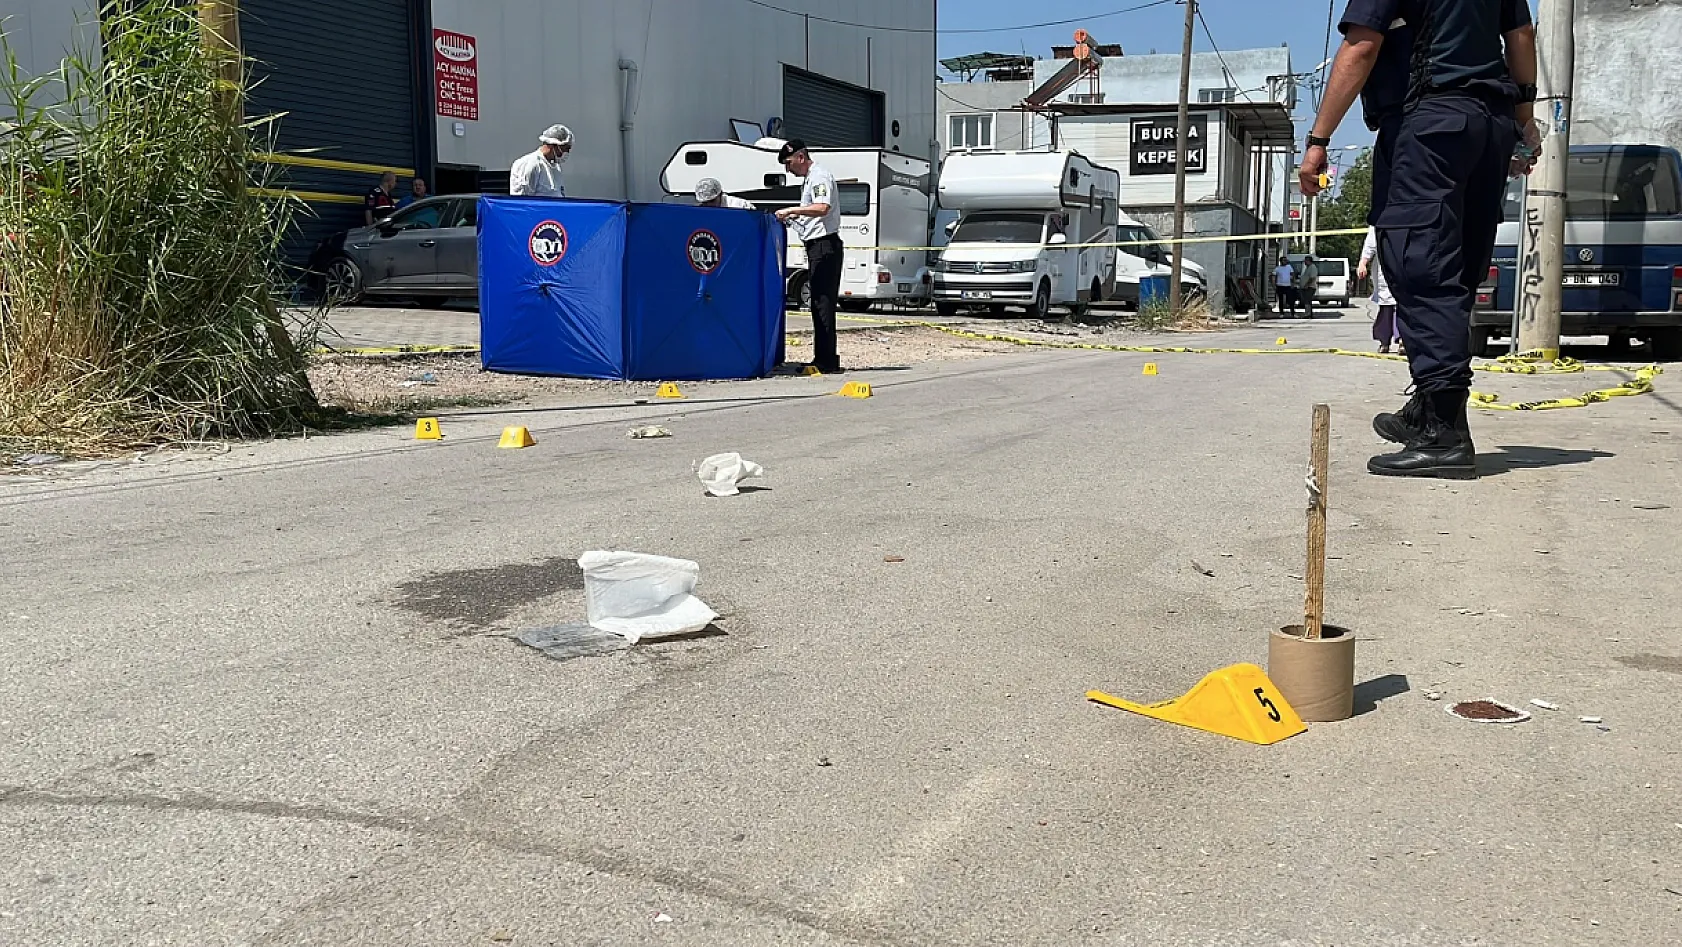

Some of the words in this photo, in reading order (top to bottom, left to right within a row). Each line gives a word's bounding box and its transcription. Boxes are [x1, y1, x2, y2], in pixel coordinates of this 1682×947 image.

[436, 61, 449, 72] ACY
[440, 80, 455, 91] CNC
[440, 90, 456, 100] CNC
[456, 92, 475, 103] Torna
[1137, 149, 1200, 164] KEPEK
[1521, 207, 1544, 321] EYMEN
[1598, 274, 1618, 284] 049
[425, 421, 432, 432] 3
[1253, 687, 1281, 722] 5
